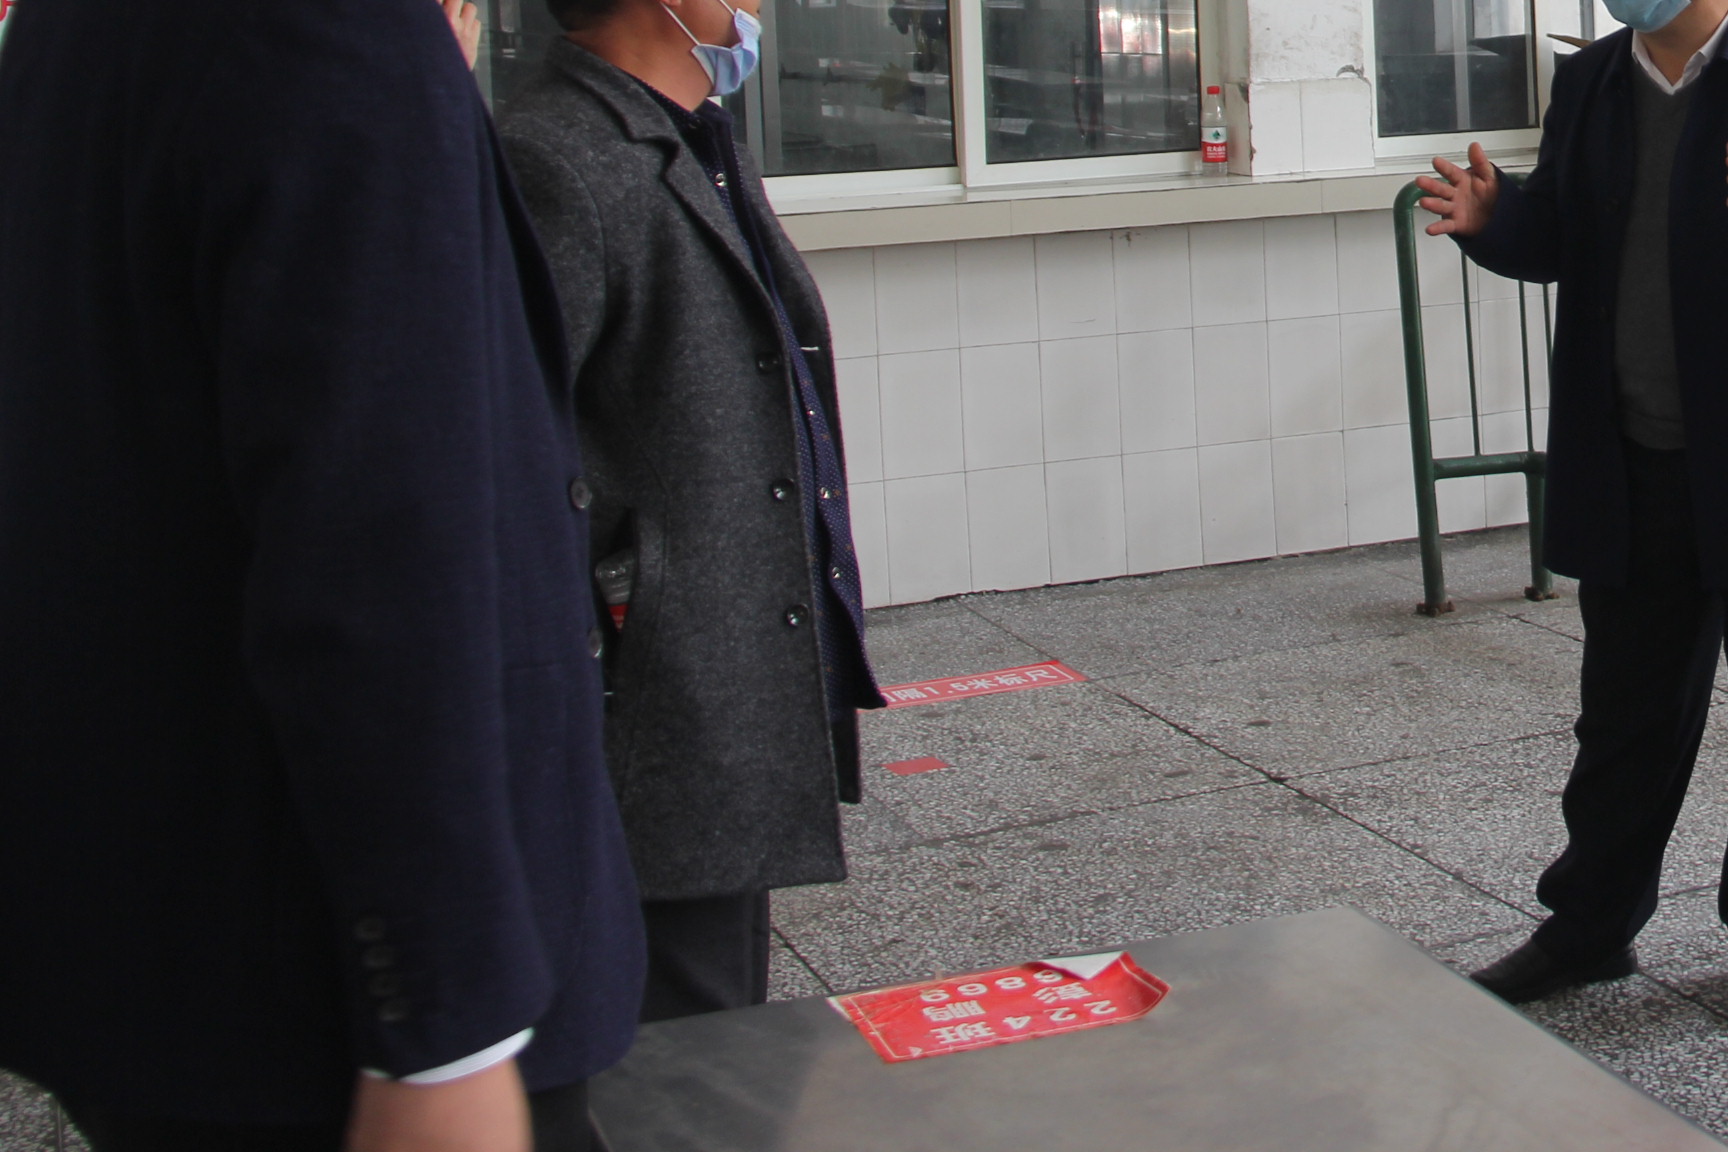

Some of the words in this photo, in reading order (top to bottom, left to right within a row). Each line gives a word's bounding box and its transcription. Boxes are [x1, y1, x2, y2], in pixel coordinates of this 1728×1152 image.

[884, 668, 1058, 703] 隔1.5米标尺
[930, 999, 1119, 1045] 224班
